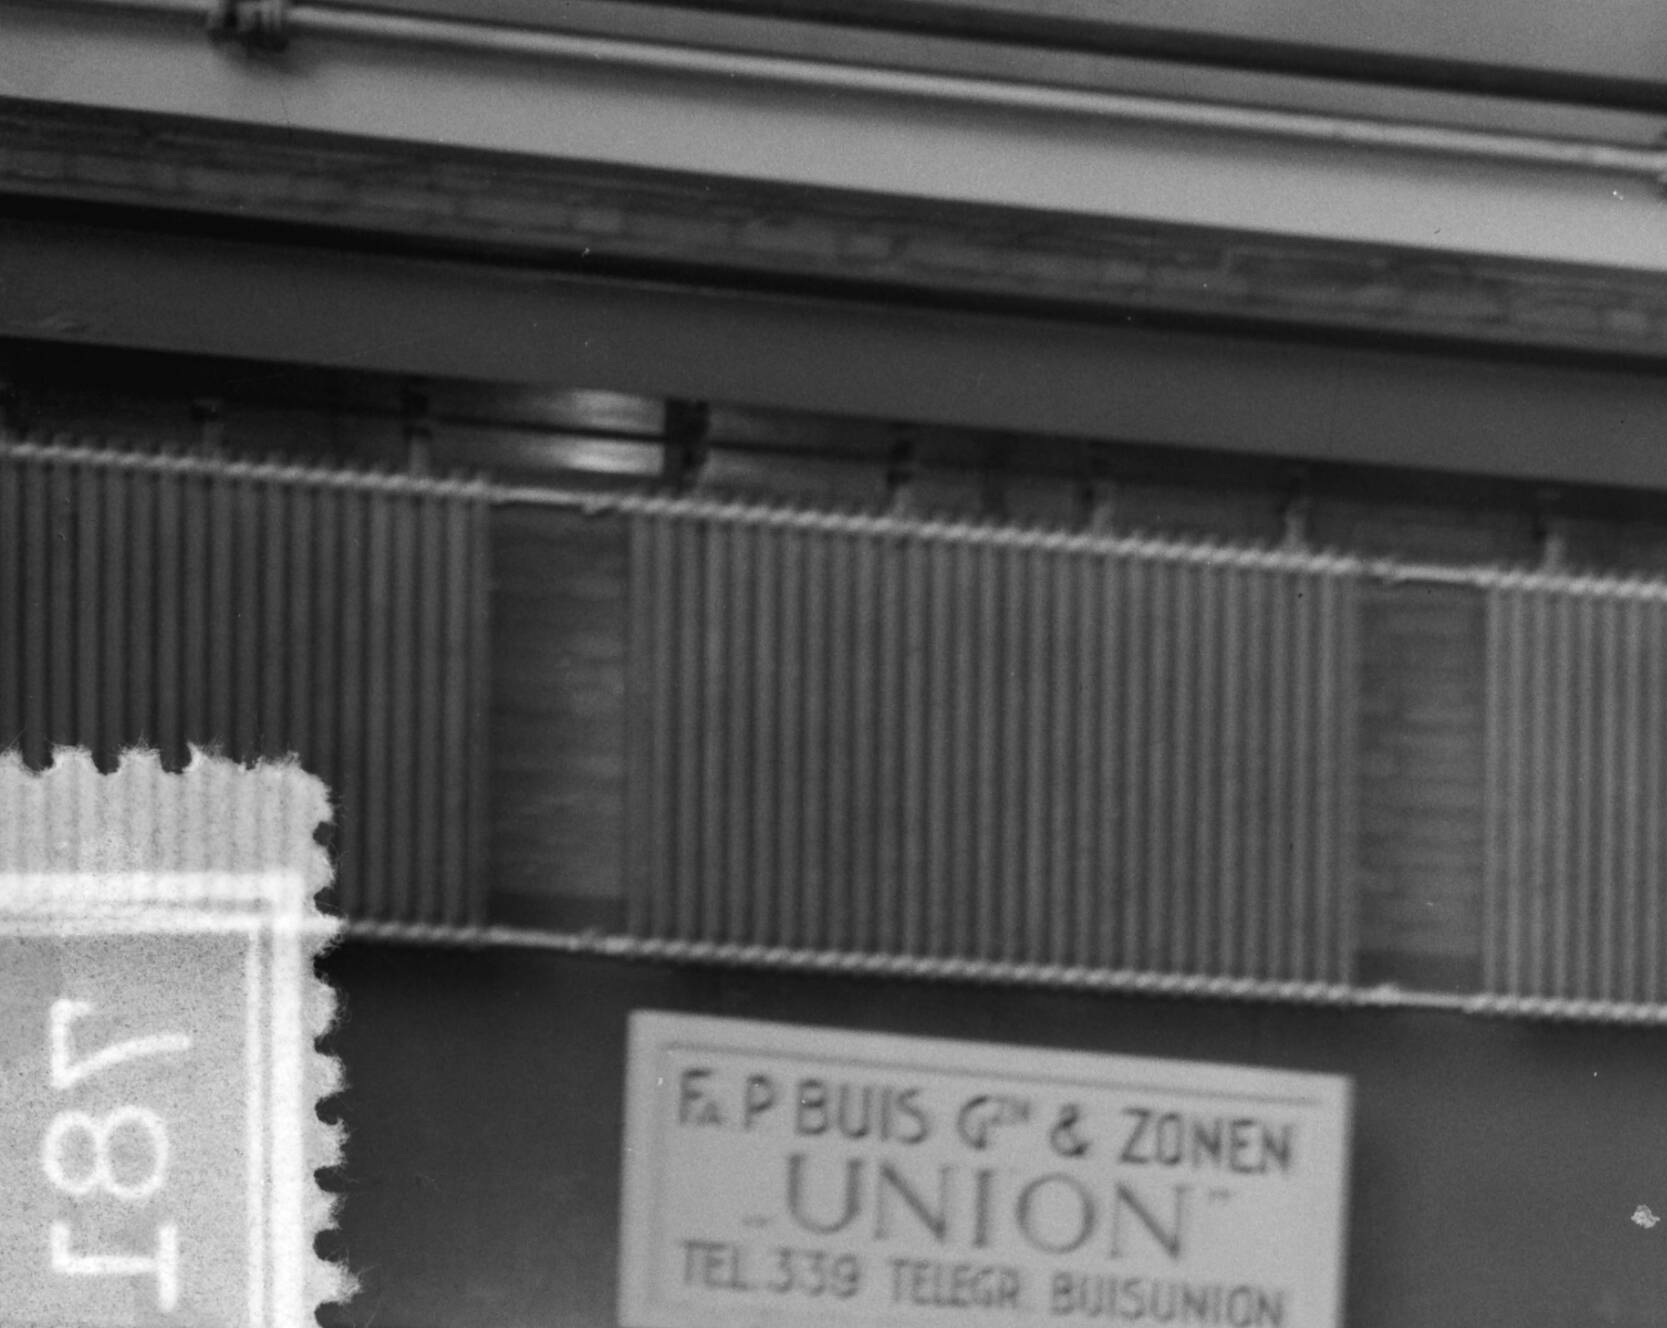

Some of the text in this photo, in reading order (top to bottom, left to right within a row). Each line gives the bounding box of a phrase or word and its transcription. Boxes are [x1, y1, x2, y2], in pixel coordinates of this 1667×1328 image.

[796, 1078, 929, 1145] BUIS
[1049, 1103, 1092, 1159] &
[1118, 1107, 1294, 1175] ZONEN
[767, 1248, 860, 1300] 339
